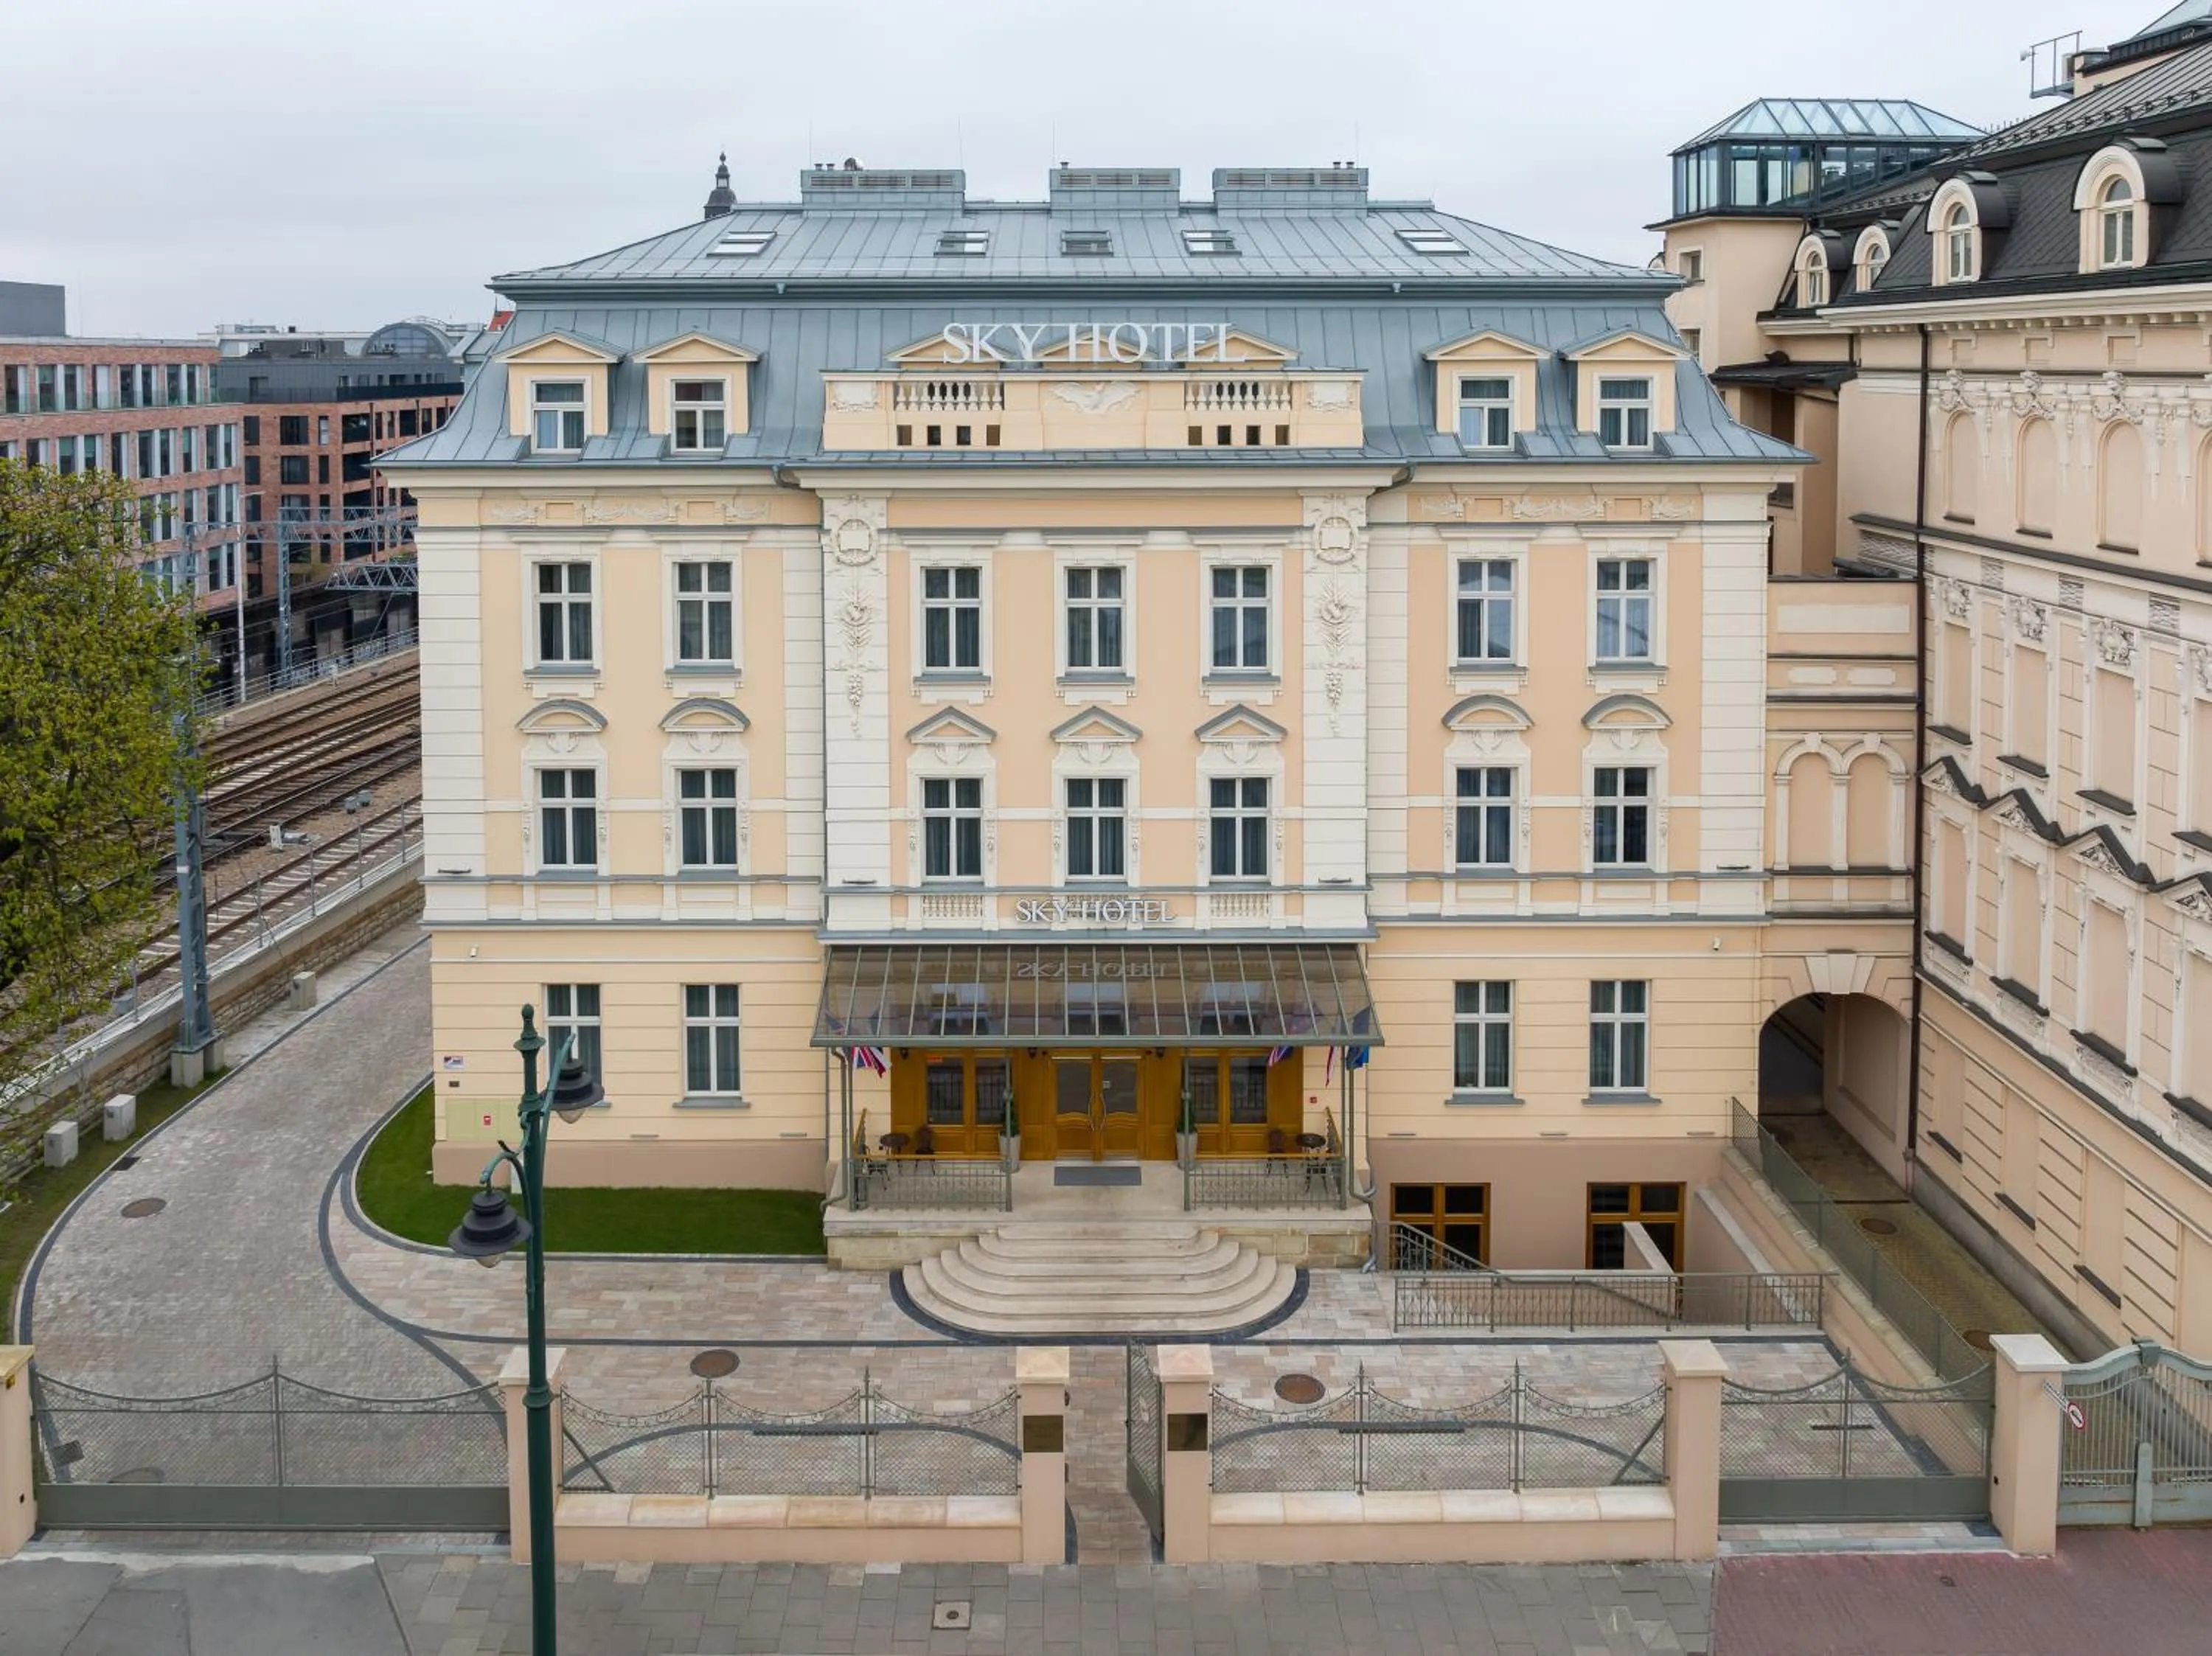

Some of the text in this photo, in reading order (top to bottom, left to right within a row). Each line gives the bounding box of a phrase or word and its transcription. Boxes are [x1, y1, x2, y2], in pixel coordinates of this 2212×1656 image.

[943, 322, 1247, 363] SKY HOTEL
[1015, 900, 1178, 922] SKY HOTEL
